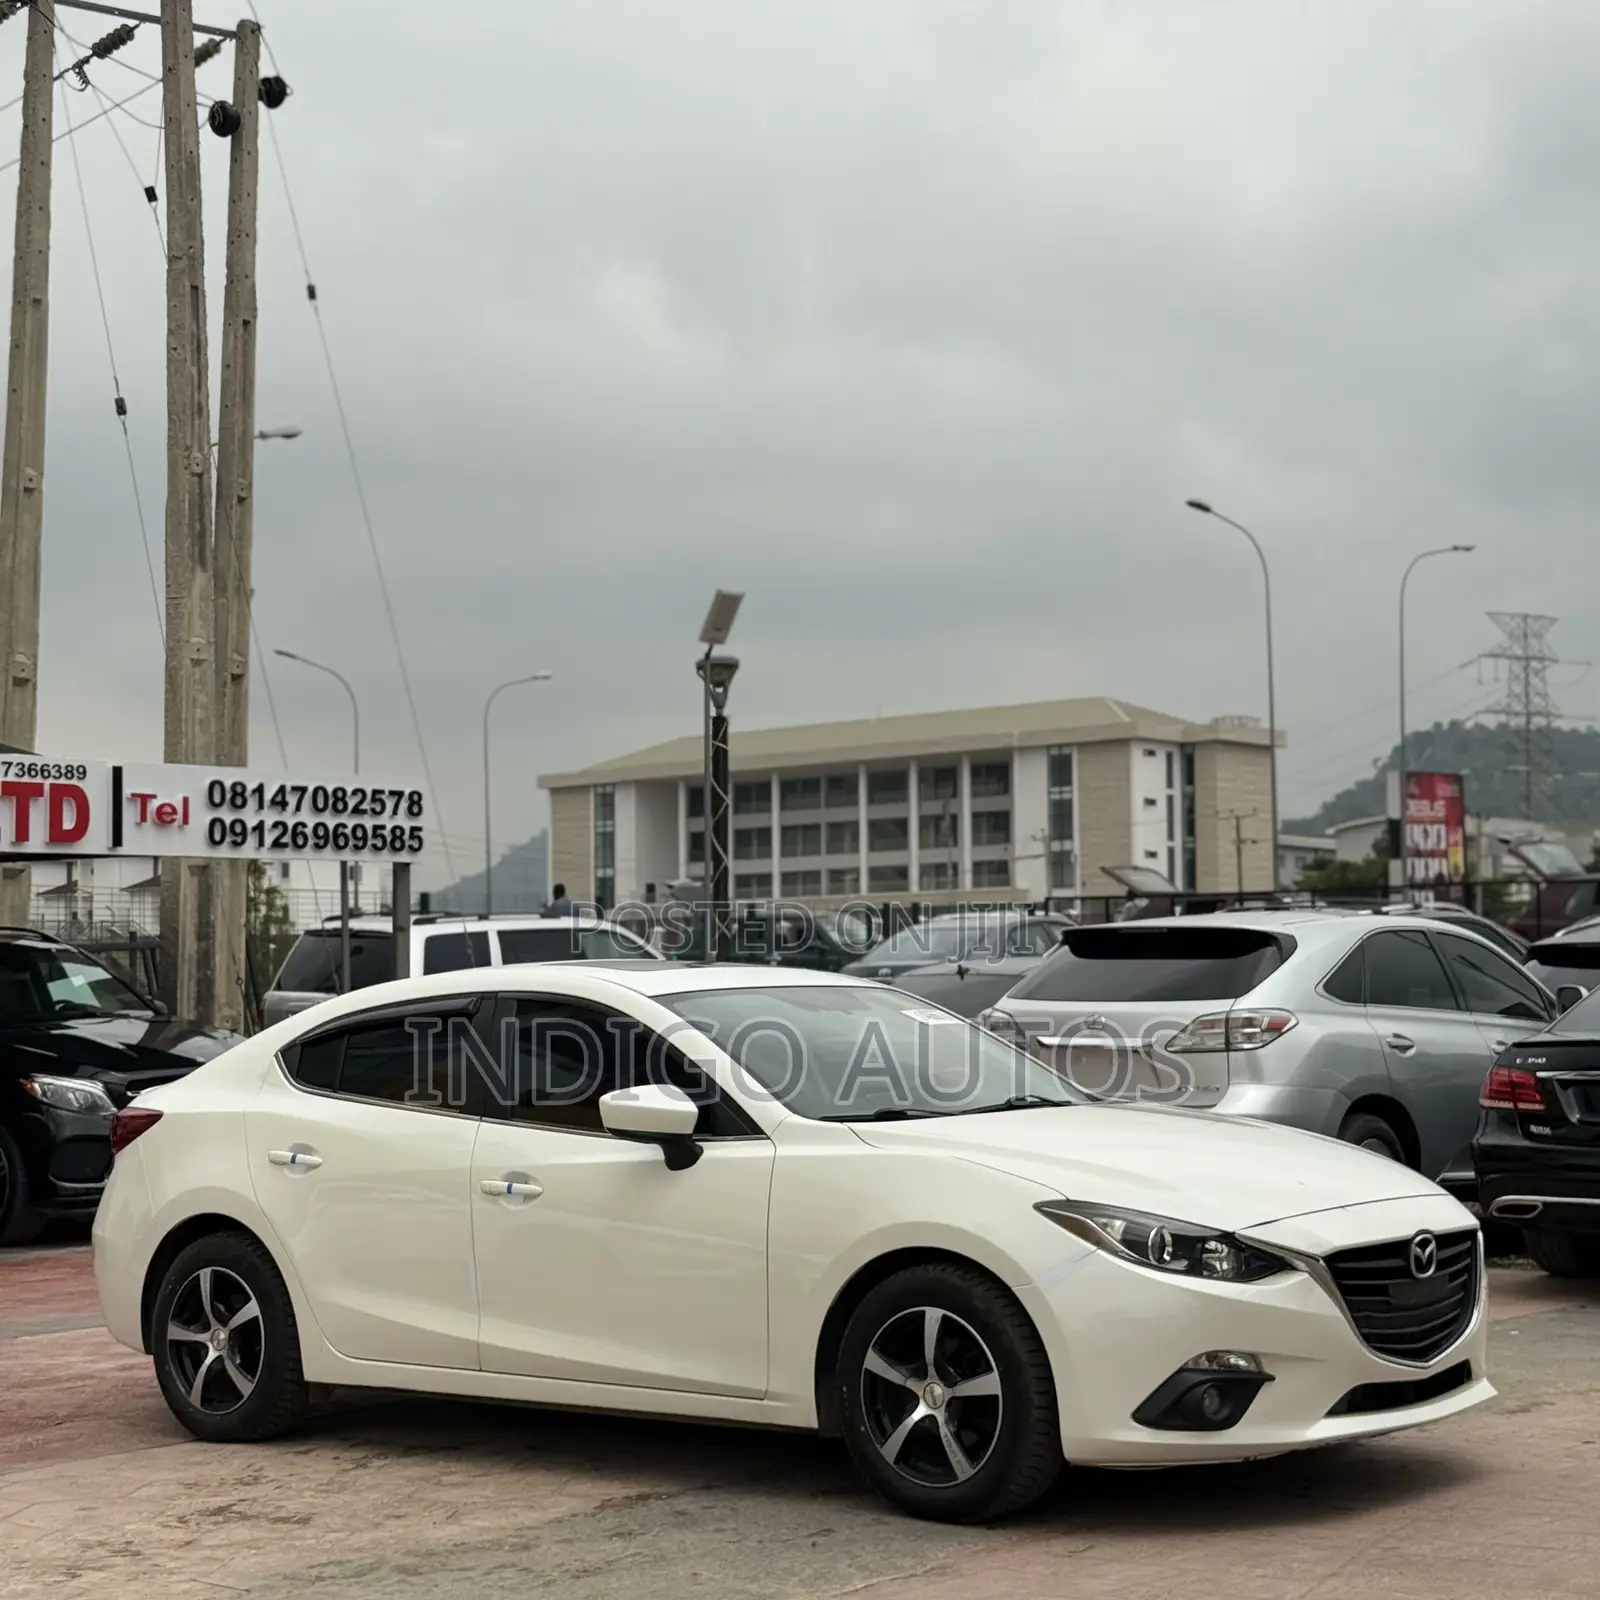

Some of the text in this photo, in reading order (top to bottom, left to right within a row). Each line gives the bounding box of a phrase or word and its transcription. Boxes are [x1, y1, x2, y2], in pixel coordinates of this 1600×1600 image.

[2, 761, 87, 780] 7366389
[0, 780, 91, 844] TD
[129, 792, 190, 827] Tel
[207, 779, 423, 818] 08147082578
[207, 817, 424, 853] 09126969585
